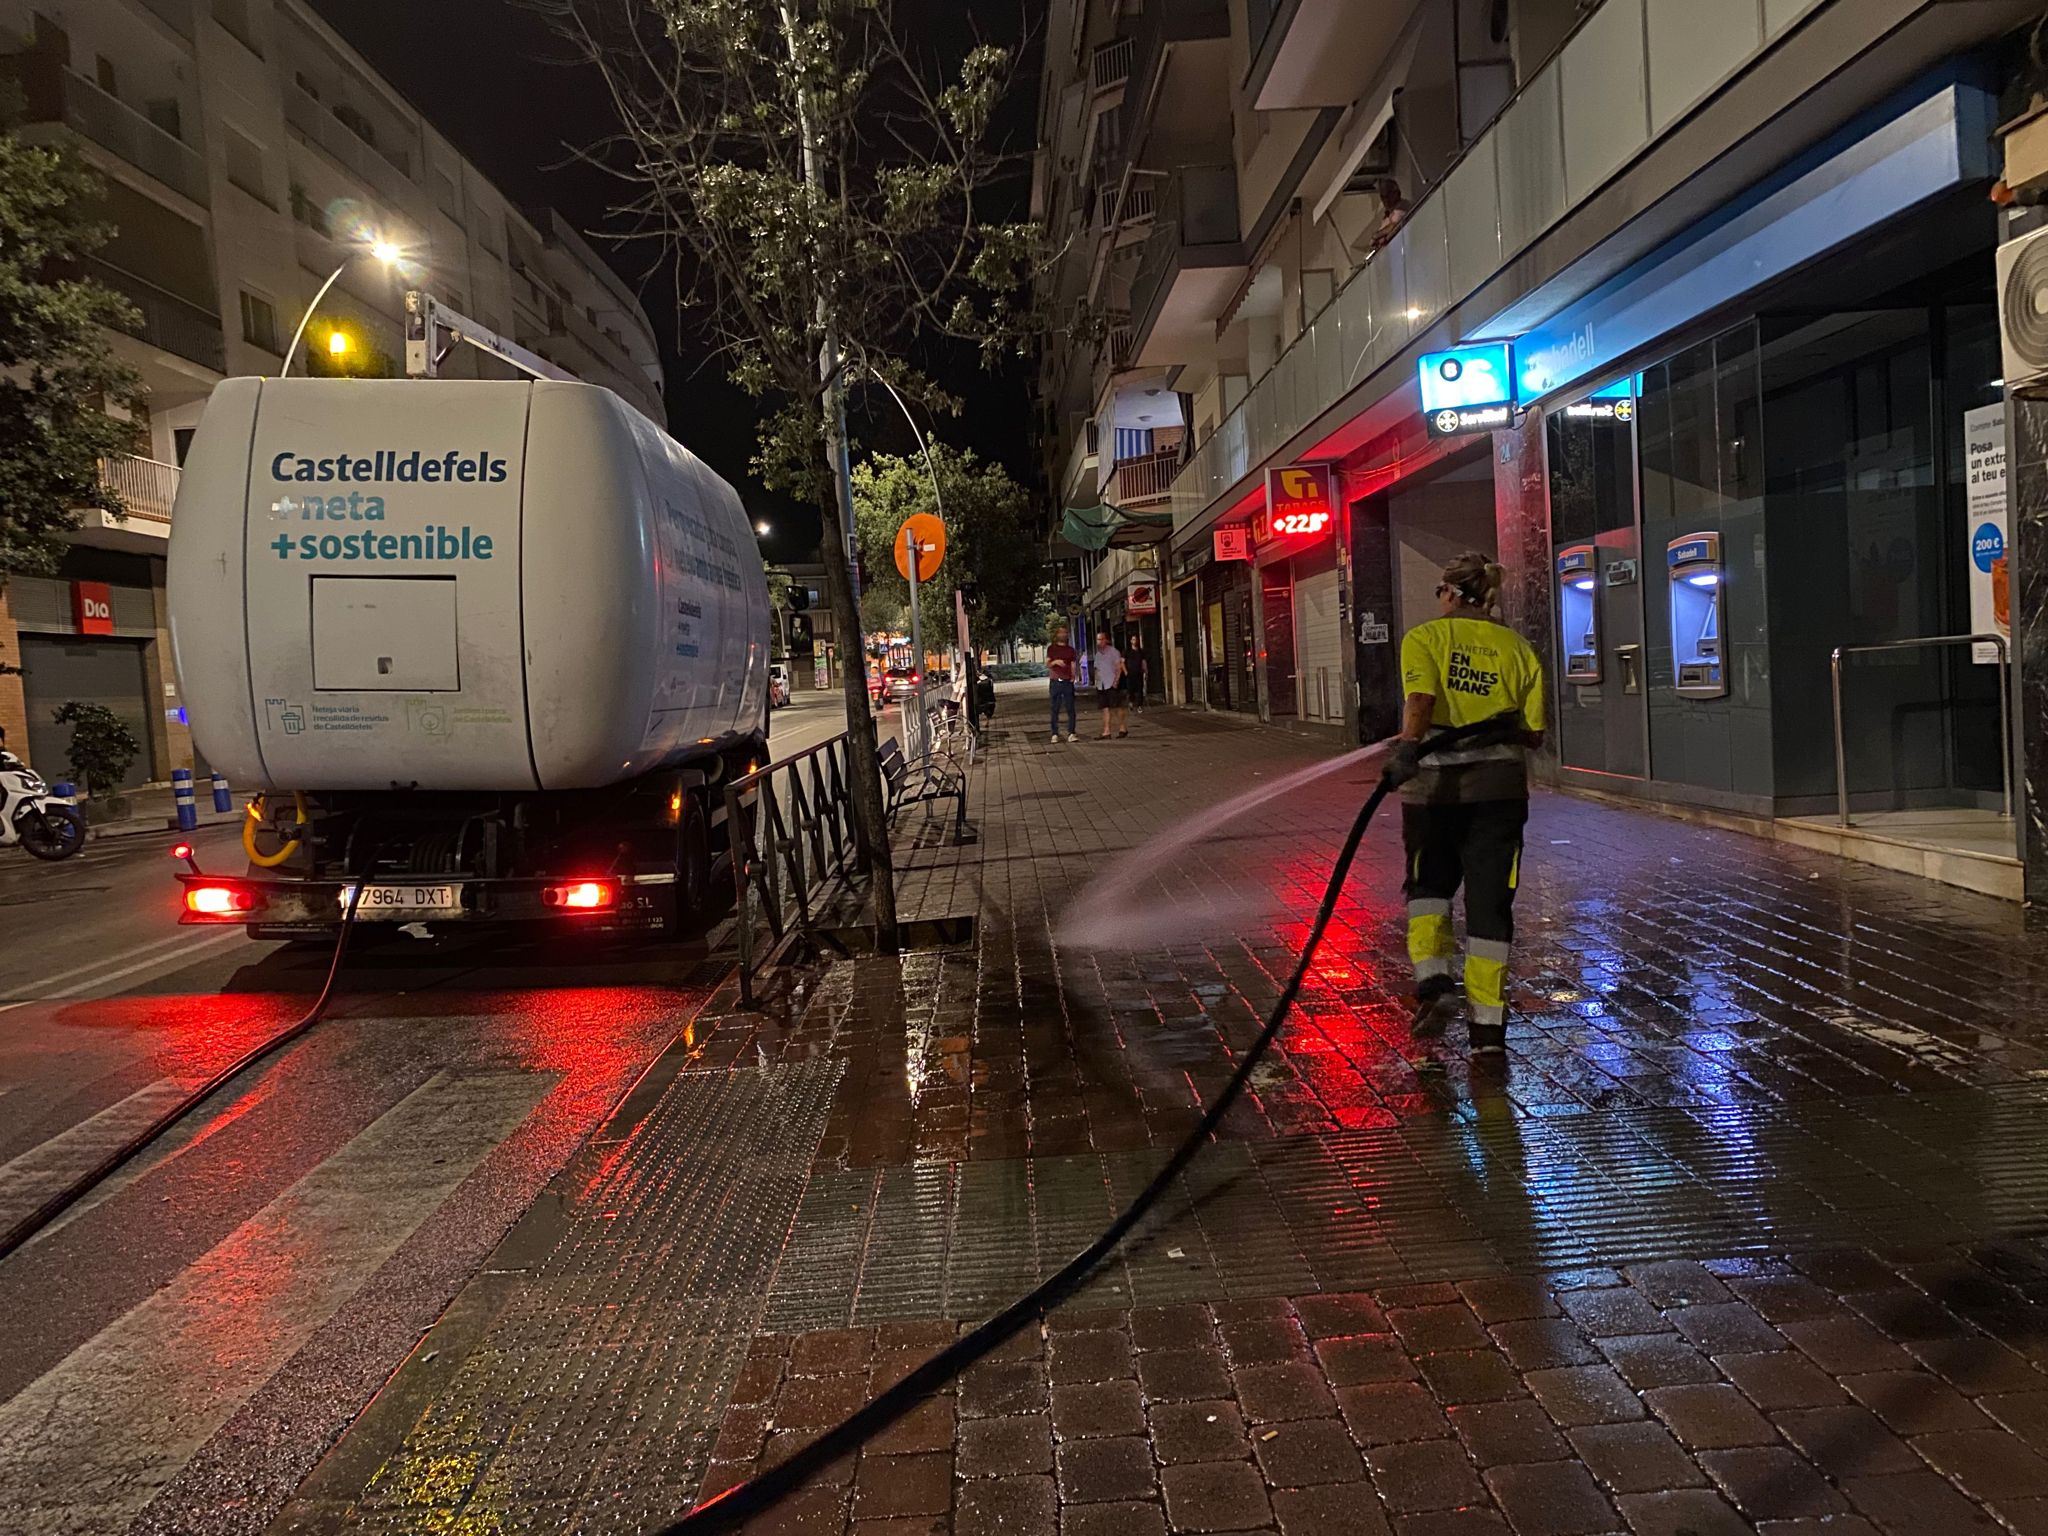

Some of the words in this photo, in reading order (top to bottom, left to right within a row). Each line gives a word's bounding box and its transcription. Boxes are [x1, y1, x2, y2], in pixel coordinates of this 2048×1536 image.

[1970, 442, 1993, 456] Posa
[271, 451, 508, 483] Castelldefels
[1971, 459, 1983, 470] un
[1971, 470, 1980, 484] al
[1982, 469, 1998, 482] teu
[1975, 538, 1992, 551] 200
[1465, 644, 1498, 658] NETEJA
[1451, 651, 1471, 667] EN
[1449, 664, 1499, 685] BONES
[1447, 677, 1492, 697] MANS
[362, 888, 404, 905] 7964
[415, 888, 447, 905] DXT
